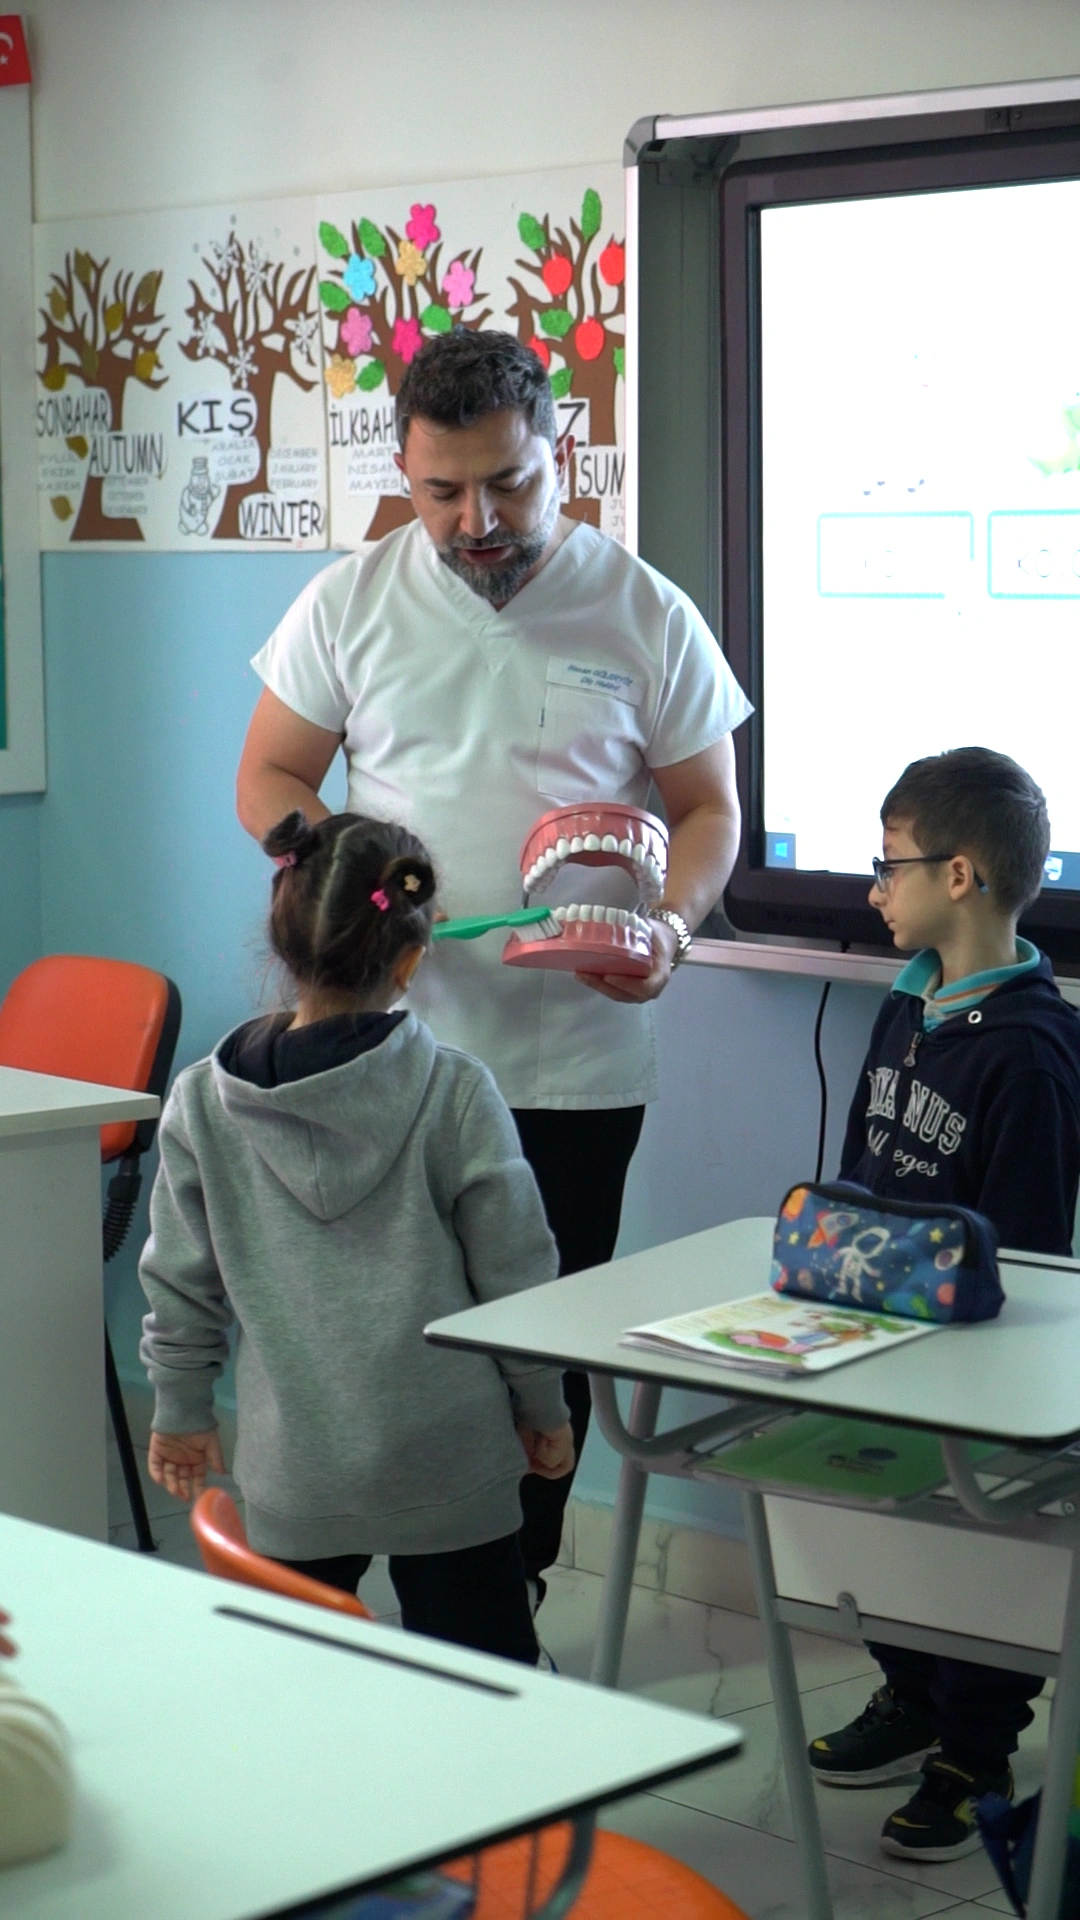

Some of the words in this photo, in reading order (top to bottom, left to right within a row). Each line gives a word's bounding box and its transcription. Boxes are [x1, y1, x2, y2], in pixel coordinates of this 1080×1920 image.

[177, 399, 254, 437] KIŞ
[329, 404, 397, 446] İLKBAH
[90, 433, 164, 474] AUTUMN
